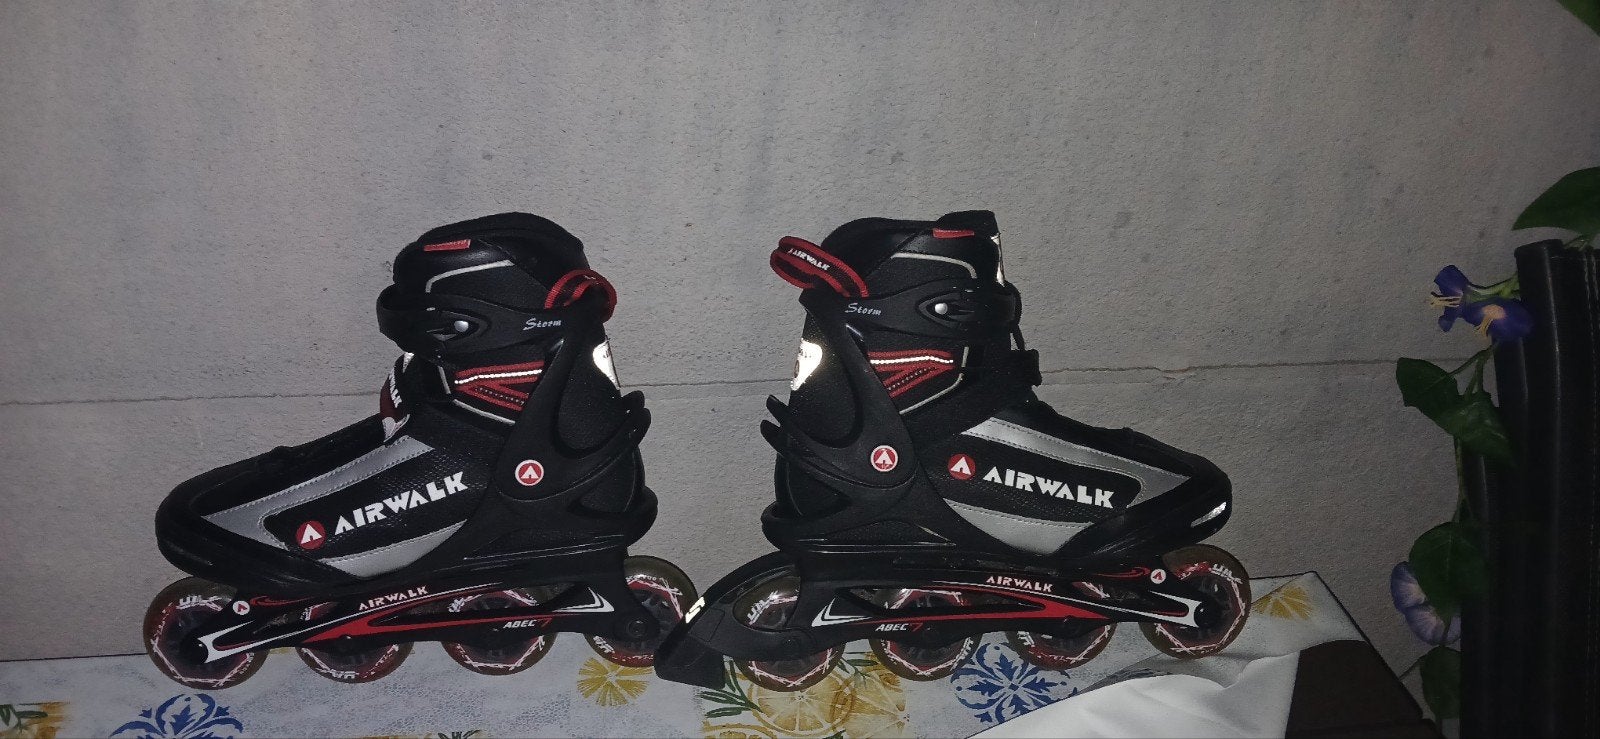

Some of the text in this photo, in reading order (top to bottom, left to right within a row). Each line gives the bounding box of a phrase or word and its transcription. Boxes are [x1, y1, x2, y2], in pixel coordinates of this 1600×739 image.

[791, 248, 830, 271] AIRWALK
[845, 302, 882, 316] Storm
[523, 318, 562, 331] Storm
[983, 466, 1115, 509] AIRWALK
[335, 471, 468, 535] AIRWALK
[986, 575, 1053, 593] AIRWALK
[358, 585, 428, 611] AIRWALK
